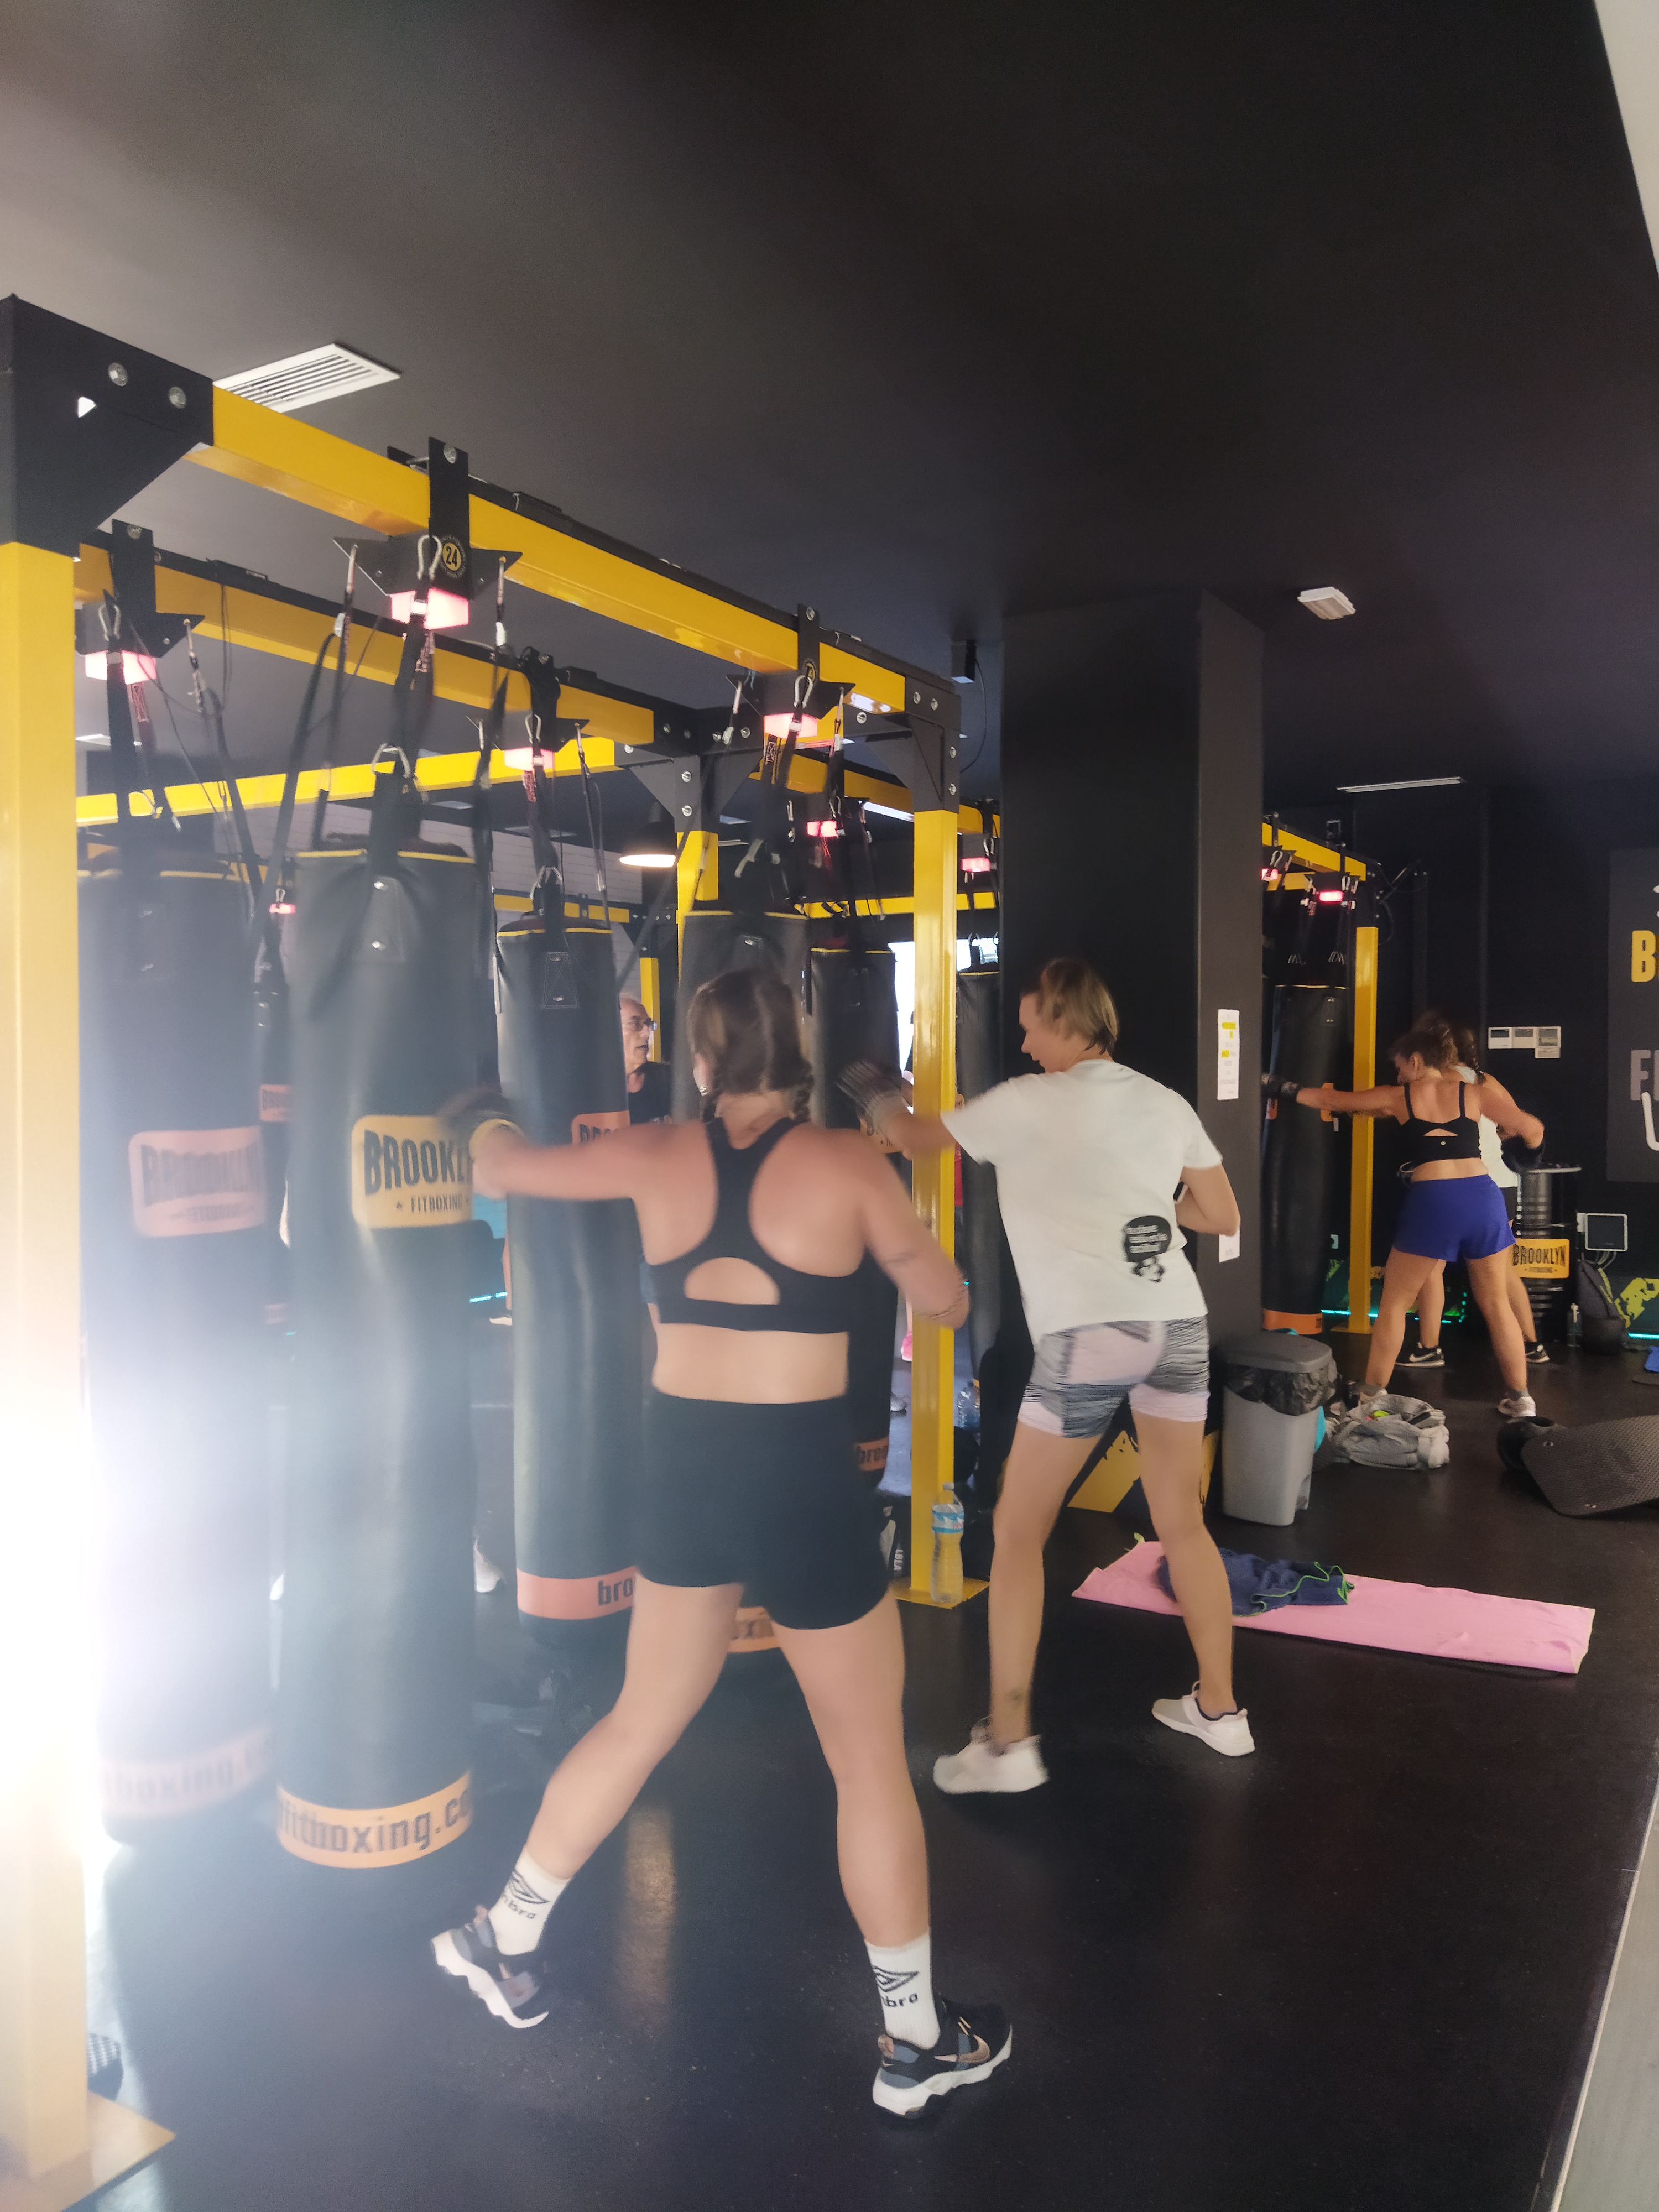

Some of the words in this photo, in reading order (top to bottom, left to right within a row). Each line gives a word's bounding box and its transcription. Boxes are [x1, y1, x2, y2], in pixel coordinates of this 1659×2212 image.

[446, 546, 458, 567] 24
[1631, 930, 1659, 982] B
[364, 1129, 472, 1197] BROOKL
[1512, 1244, 1566, 1267] BROOKLYN
[881, 1993, 918, 2007] bro
